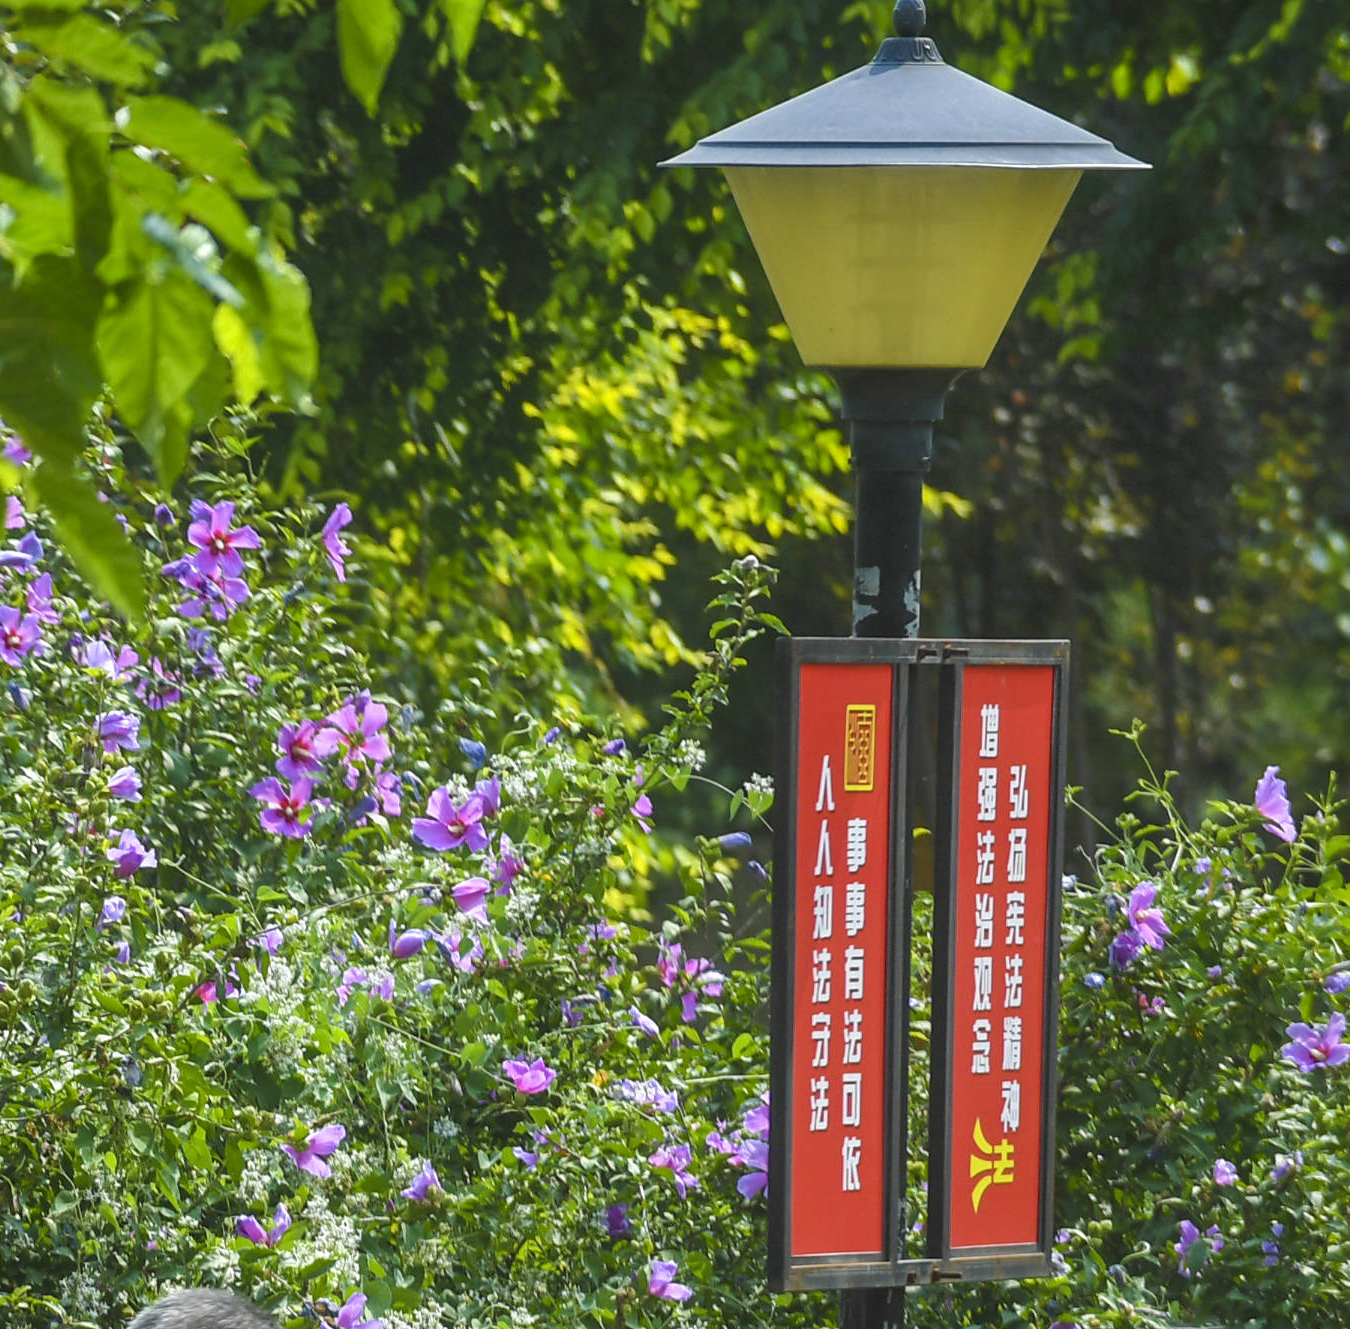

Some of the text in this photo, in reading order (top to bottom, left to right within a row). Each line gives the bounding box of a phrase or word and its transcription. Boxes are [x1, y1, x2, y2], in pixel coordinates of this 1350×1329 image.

[809, 754, 836, 1132] 人人知法守法
[841, 817, 868, 1192] 事事有法可依
[971, 703, 1000, 1074] 增强法治观念
[1000, 764, 1029, 1133] 弘扬宪法精神
